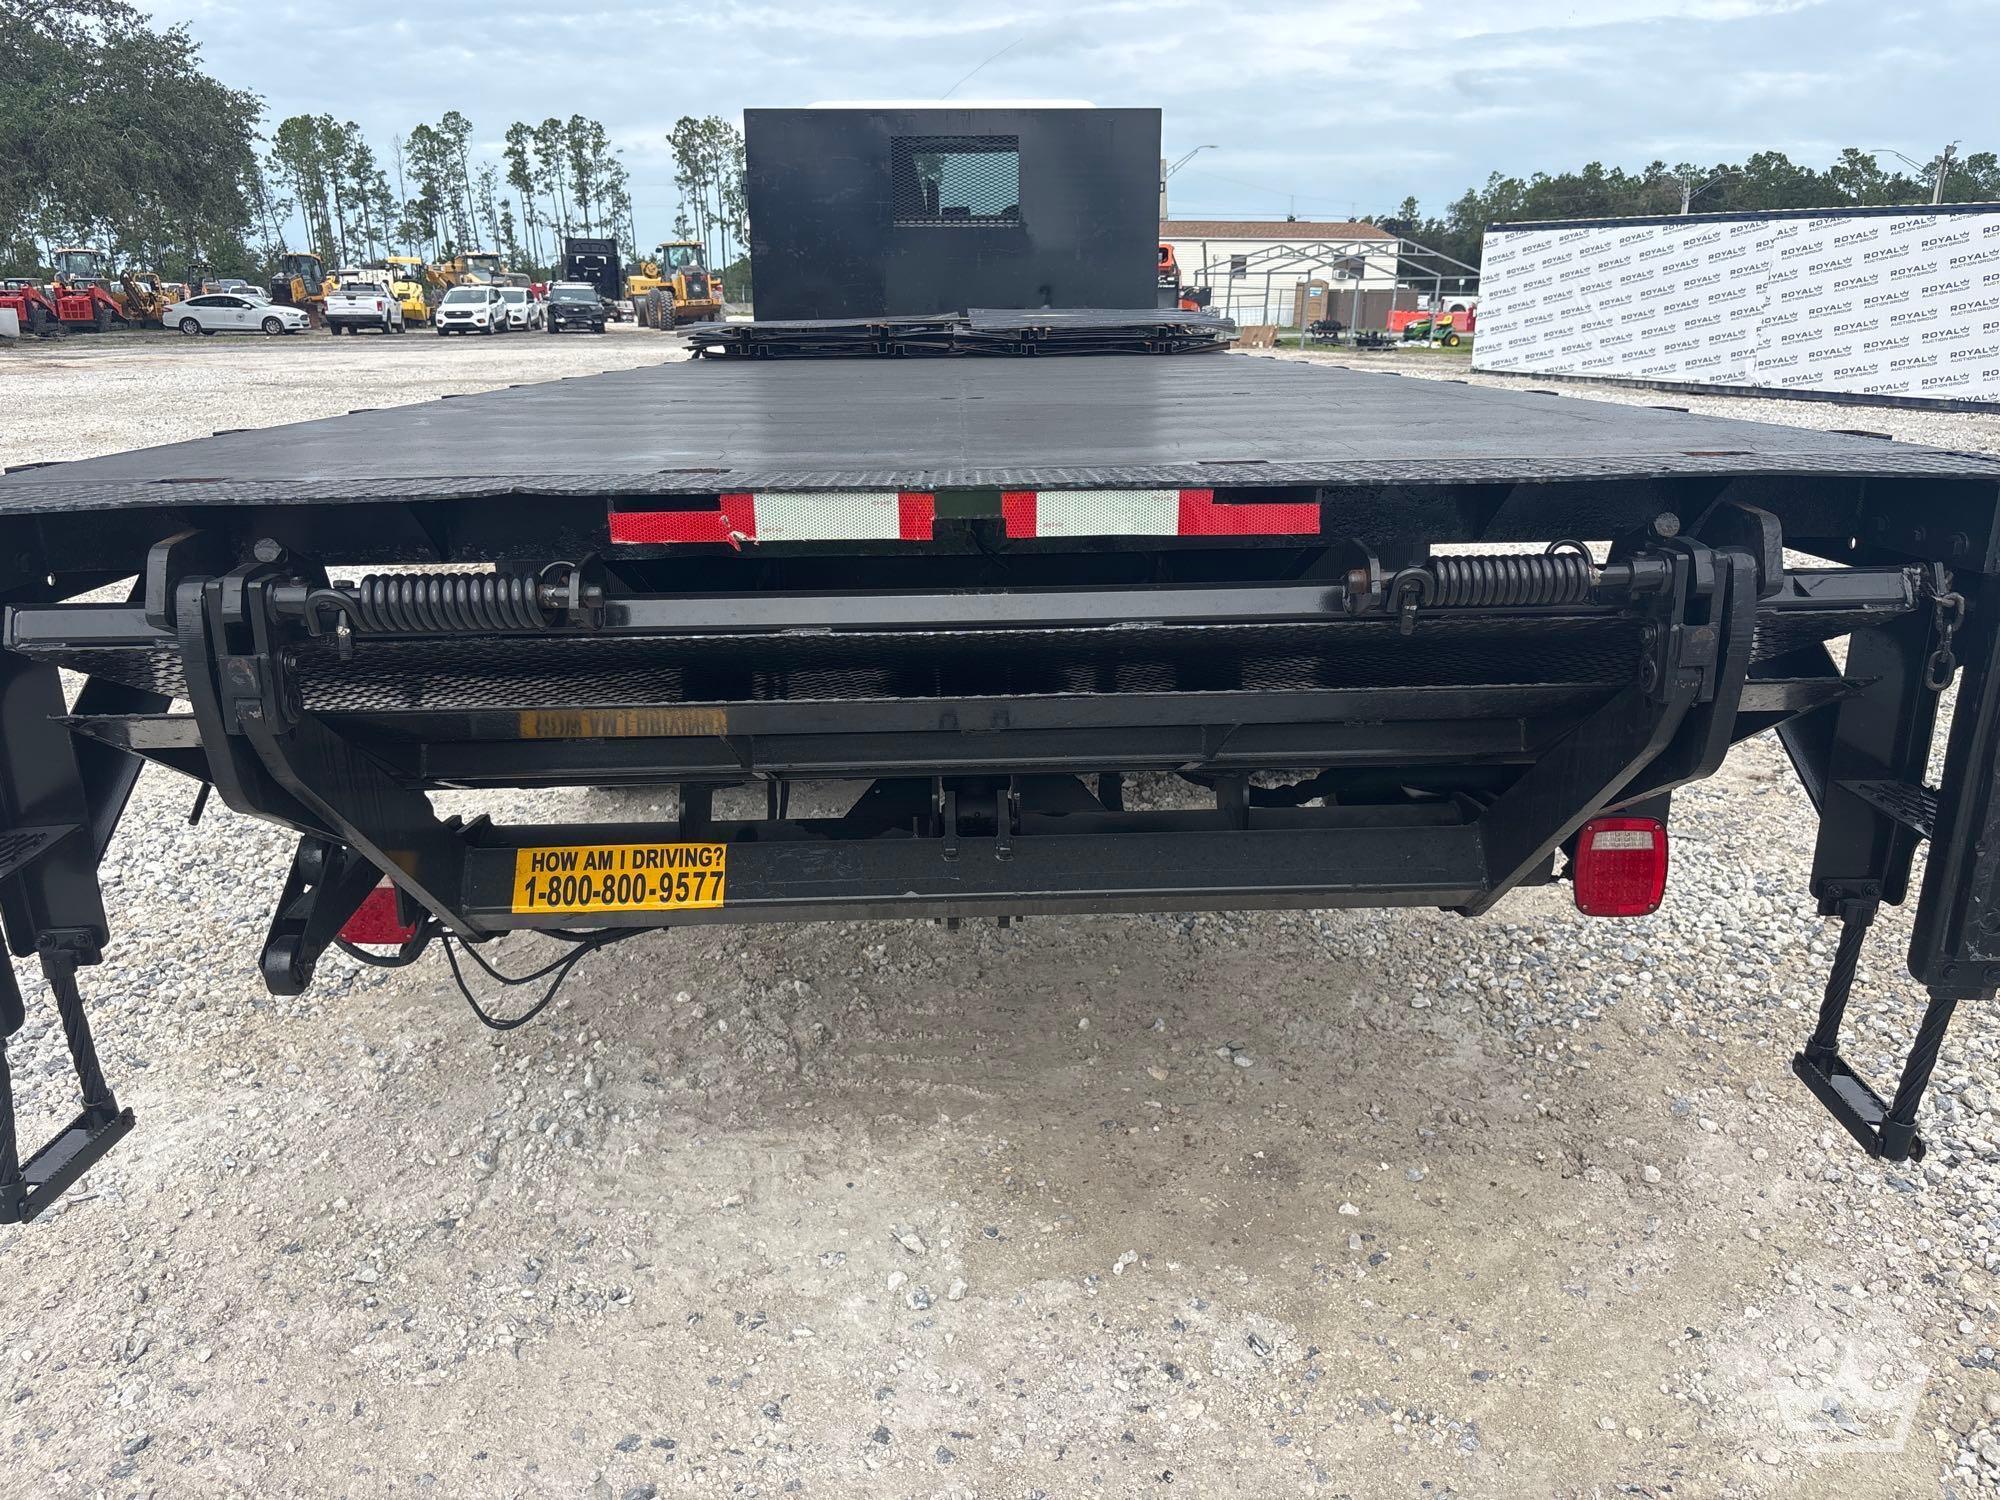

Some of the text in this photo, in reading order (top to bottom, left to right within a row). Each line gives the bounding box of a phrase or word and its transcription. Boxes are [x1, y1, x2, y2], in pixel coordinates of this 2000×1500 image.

[1730, 221, 1760, 233] ROYAL
[1809, 224, 1832, 232] AUCTION
[1890, 217, 1926, 231] ROYAL
[1559, 230, 1583, 241] ROYAL
[1890, 227, 1915, 235] AUCTION
[1619, 232, 1646, 243] ROYAL
[1683, 234, 1711, 246] ROYAL
[1834, 231, 1868, 244] ROYAL
[1921, 234, 1959, 247] ROYAL
[1522, 242, 1545, 252] ROYAL
[1579, 243, 1604, 254] ROYAL
[1834, 240, 1858, 248] AUCTION
[1922, 243, 1947, 251] AUCTION
[1639, 246, 1666, 257] ROYAL
[1708, 248, 1737, 260] ROYAL
[1781, 244, 1813, 256] ROYAL
[1864, 247, 1899, 259] ROYAL
[1487, 252, 1509, 262] ROYAL
[1542, 254, 1565, 265] ROYAL
[1781, 252, 1803, 260] AUCTION
[1864, 256, 1888, 264] AUCTION
[1950, 252, 1988, 264] ROYAL
[1598, 258, 1623, 268] ROYAL
[1662, 260, 1690, 271] ROYAL
[1809, 259, 1842, 271] ROYAL
[1950, 261, 1976, 269] AUCTION
[1506, 265, 1528, 275] ROYAL
[1560, 268, 1584, 278] ROYAL
[1730, 263, 1760, 275] ROYAL
[1890, 264, 1926, 276] ROYAL
[1620, 271, 1646, 282] ROYAL
[1684, 275, 1712, 286] ROYAL
[1891, 273, 1915, 281] AUCTION
[1523, 278, 1546, 288] ROYAL
[1580, 282, 1605, 292] ROYAL
[1834, 276, 1868, 288] ROYAL
[1921, 281, 1959, 293] ROYAL
[1489, 288, 1510, 297] ROYAL
[1640, 286, 1667, 297] ROYAL
[1781, 287, 1813, 299] ROYAL
[1834, 284, 1858, 292] AUCTION
[1543, 291, 1566, 301] ROYAL
[1708, 290, 1737, 301] ROYAL
[1864, 293, 1899, 304] ROYAL
[1922, 290, 1947, 298] AUCTION
[1507, 301, 1529, 310] ROYAL
[1599, 296, 1624, 306] ROYAL
[1664, 300, 1691, 311] ROYAL
[1864, 301, 1888, 309] AUCTION
[1950, 299, 1988, 311] ROYAL
[1560, 306, 1584, 315] ROYAL
[1730, 305, 1760, 316] ROYAL
[1808, 303, 1842, 314] ROYAL
[1950, 308, 1976, 316] AUCTION
[1524, 314, 1547, 324] ROYAL
[1621, 310, 1647, 320] ROYAL
[1890, 310, 1927, 321] ROYAL
[1581, 320, 1606, 329] ROYAL
[1684, 316, 1713, 326] ROYAL
[1490, 323, 1511, 331] ROYAL
[1641, 325, 1668, 335] ROYAL
[1833, 321, 1868, 332] ROYAL
[1543, 328, 1567, 337] ROYAL
[1708, 331, 1738, 341] ROYAL
[1781, 330, 1813, 341] ROYAL
[1922, 328, 1959, 339] ROYAL
[1508, 336, 1530, 345] ROYAL
[1599, 334, 1625, 344] ROYAL
[1863, 338, 1899, 348] ROYAL
[1475, 344, 1495, 352] ROYAL
[1561, 343, 1585, 352] ROYAL
[1664, 340, 1691, 350] ROYAL
[1525, 350, 1547, 359] ROYAL
[1621, 349, 1648, 358] ROYAL
[1808, 347, 1842, 358] ROYAL
[1950, 347, 1988, 358] ROYAL
[1491, 358, 1512, 366] ROYAL
[1581, 357, 1606, 366] ROYAL
[1685, 356, 1713, 366] ROYAL
[1758, 356, 1789, 366] ROYAL
[1890, 356, 1927, 367] ROYAL
[1641, 365, 1668, 374] ROYAL
[1833, 365, 1868, 375] ROYAL
[1709, 372, 1738, 381] ROYAL
[1781, 374, 1814, 383] ROYAL
[1921, 375, 1959, 385] ROYAL
[1863, 383, 1899, 392] ROYAL
[531, 847, 724, 872] HOW AM I DRIVING?
[525, 871, 724, 907] 1-800-800-9577
